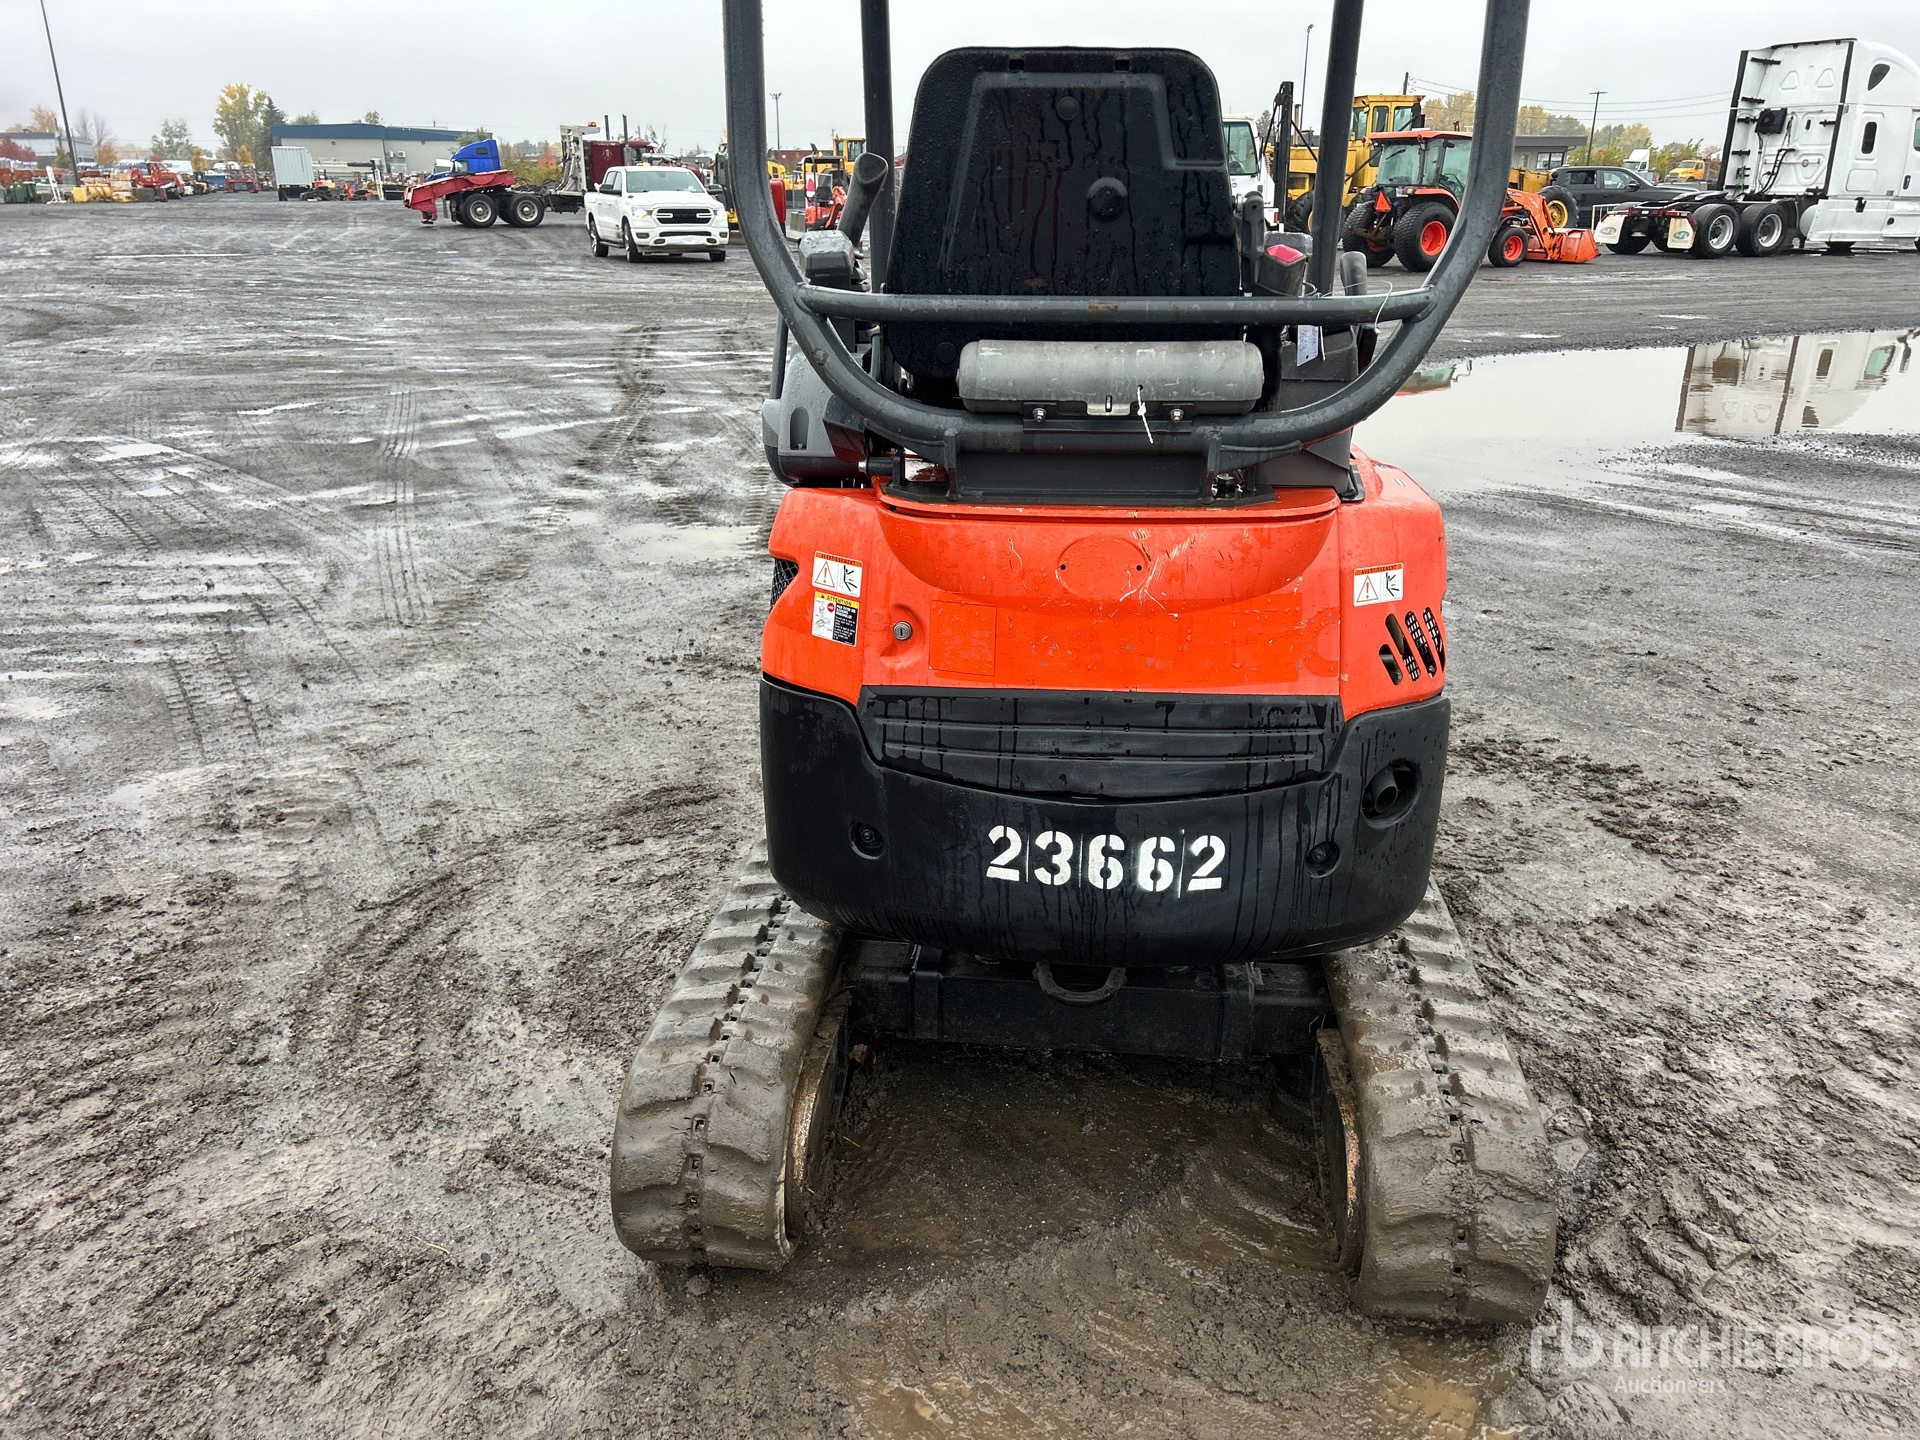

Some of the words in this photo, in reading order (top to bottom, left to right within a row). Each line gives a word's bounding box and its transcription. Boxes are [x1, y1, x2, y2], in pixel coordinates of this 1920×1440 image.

[1361, 565, 1397, 574] AVERTISSEMENT
[826, 595, 852, 606] ATTENTION
[986, 824, 1226, 892] 23662
